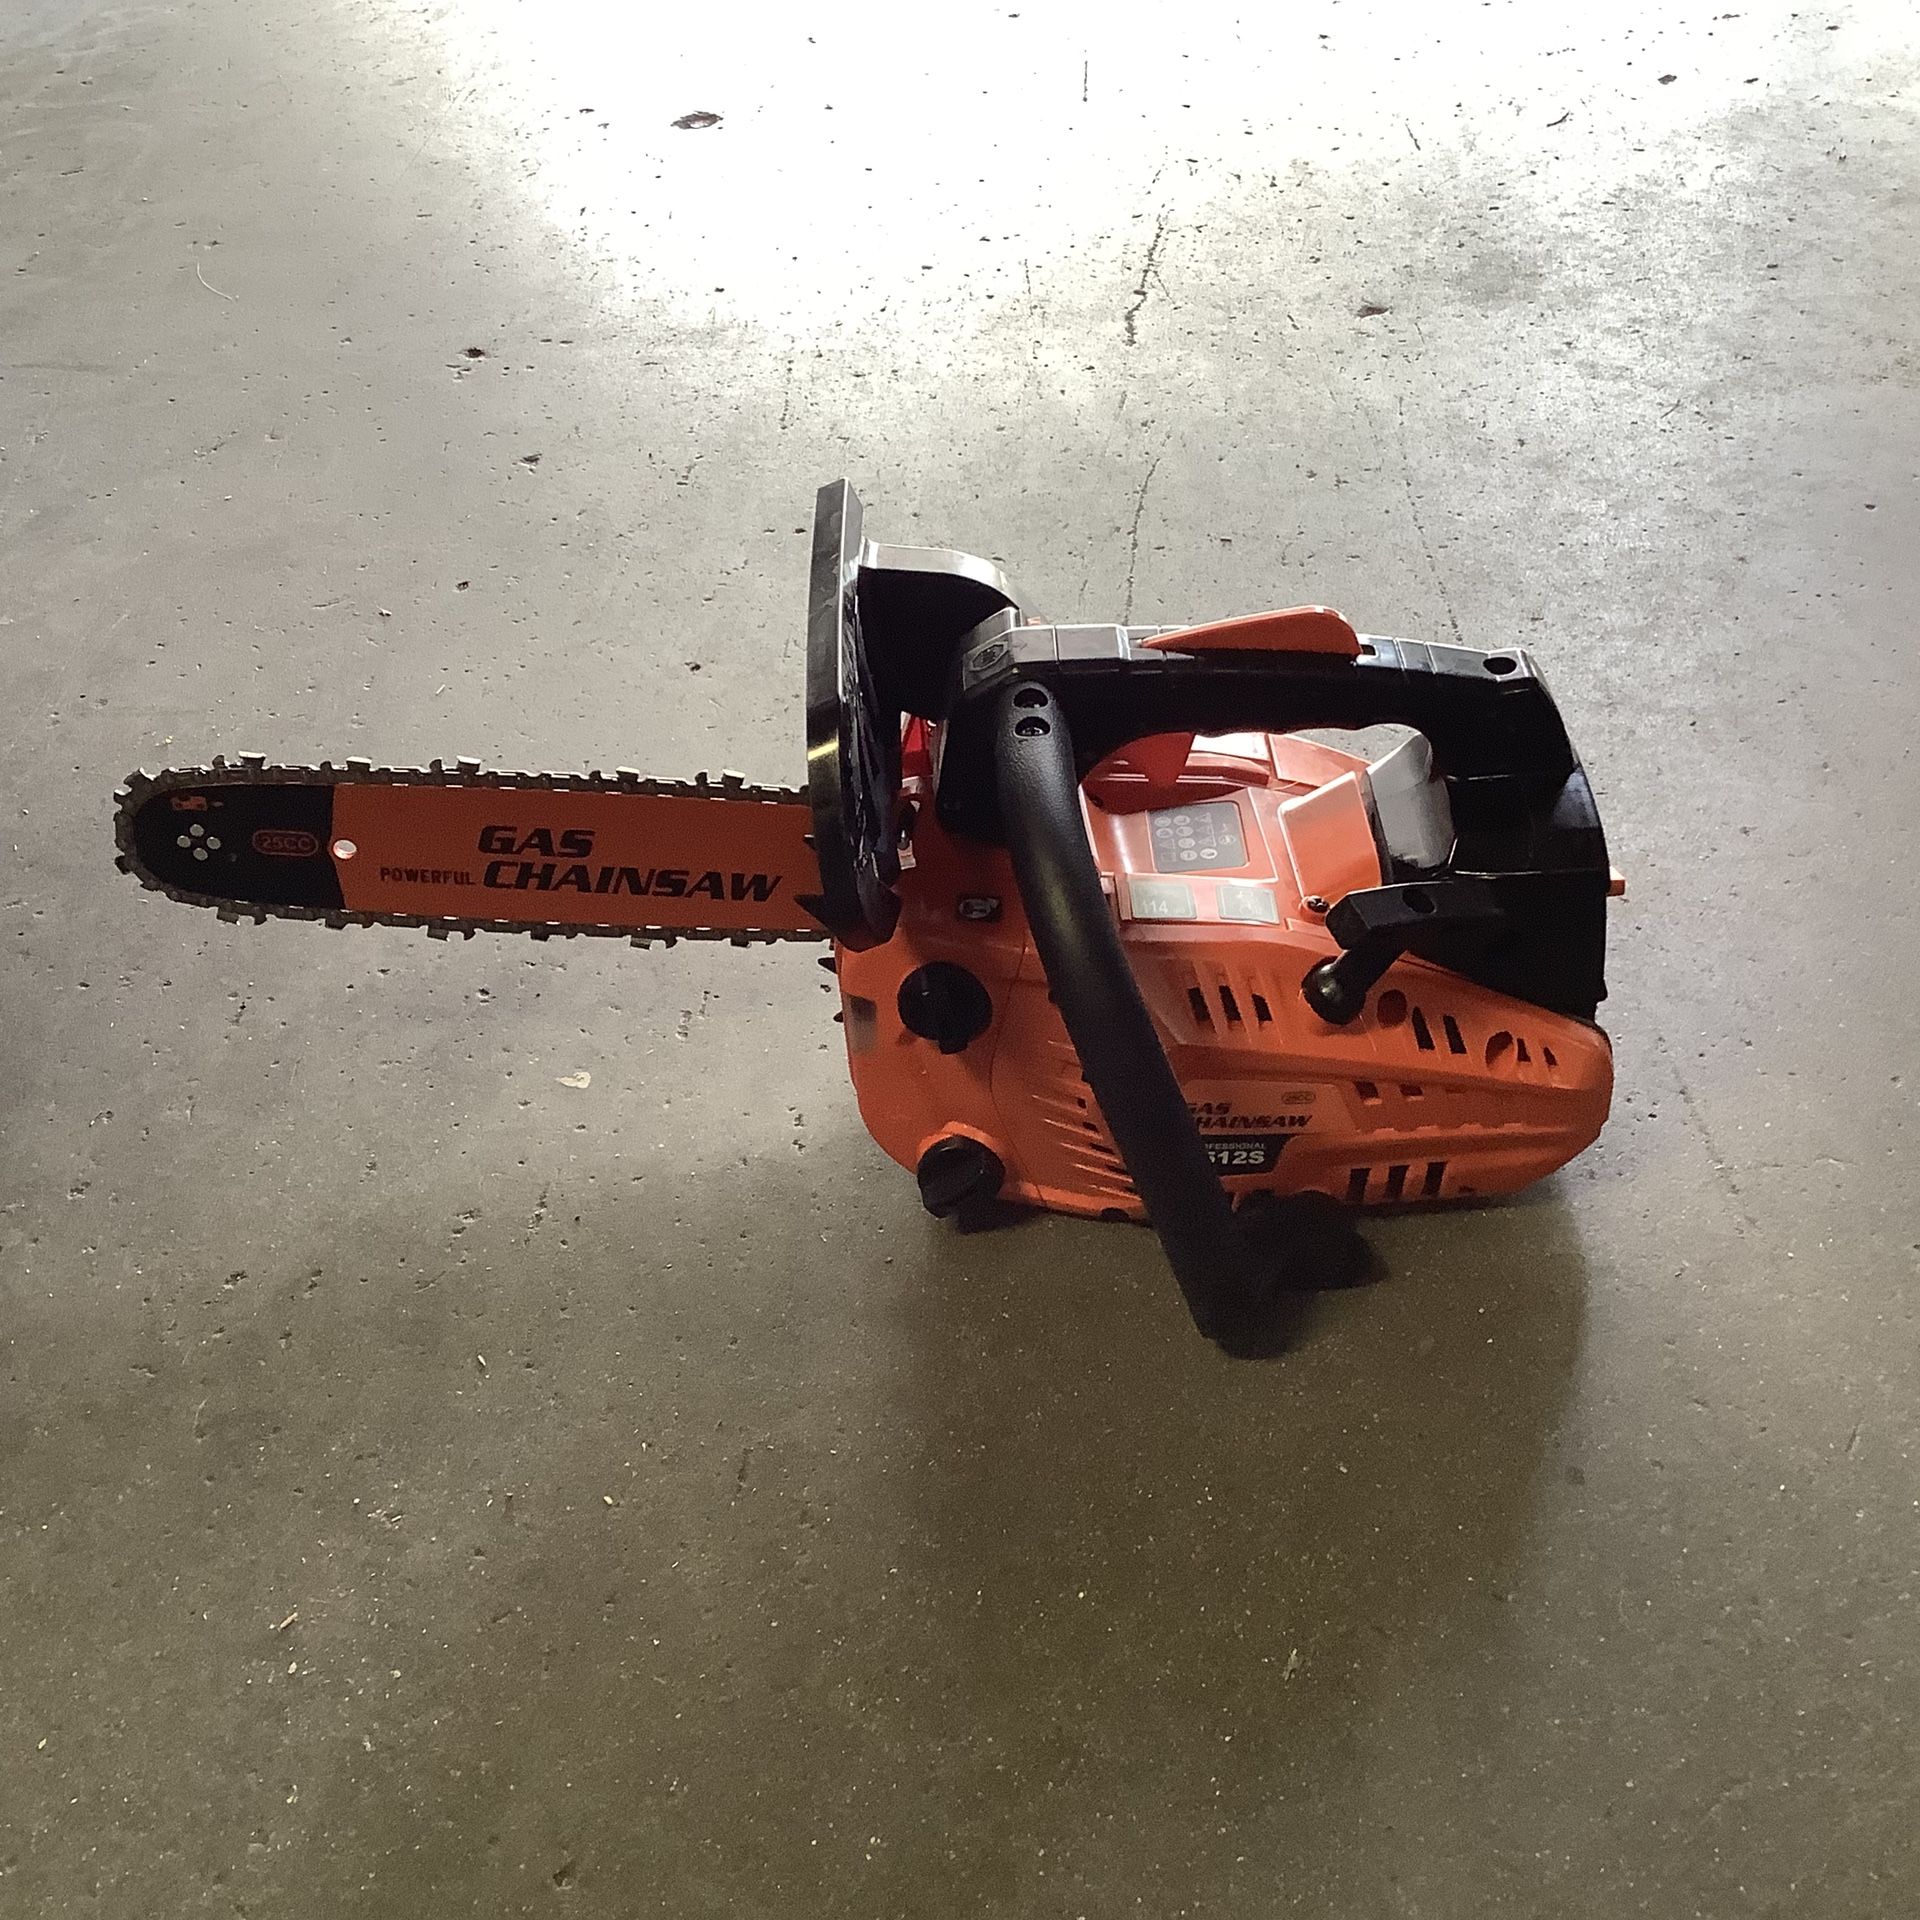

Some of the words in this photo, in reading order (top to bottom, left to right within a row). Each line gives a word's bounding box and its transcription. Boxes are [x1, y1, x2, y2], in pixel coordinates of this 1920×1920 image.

[261, 835, 312, 852] 25CC
[477, 824, 597, 858] GAS
[379, 866, 476, 887] POWERFUL
[483, 860, 783, 903] CHAINSAW
[1195, 1114, 1313, 1129] HAINSAW
